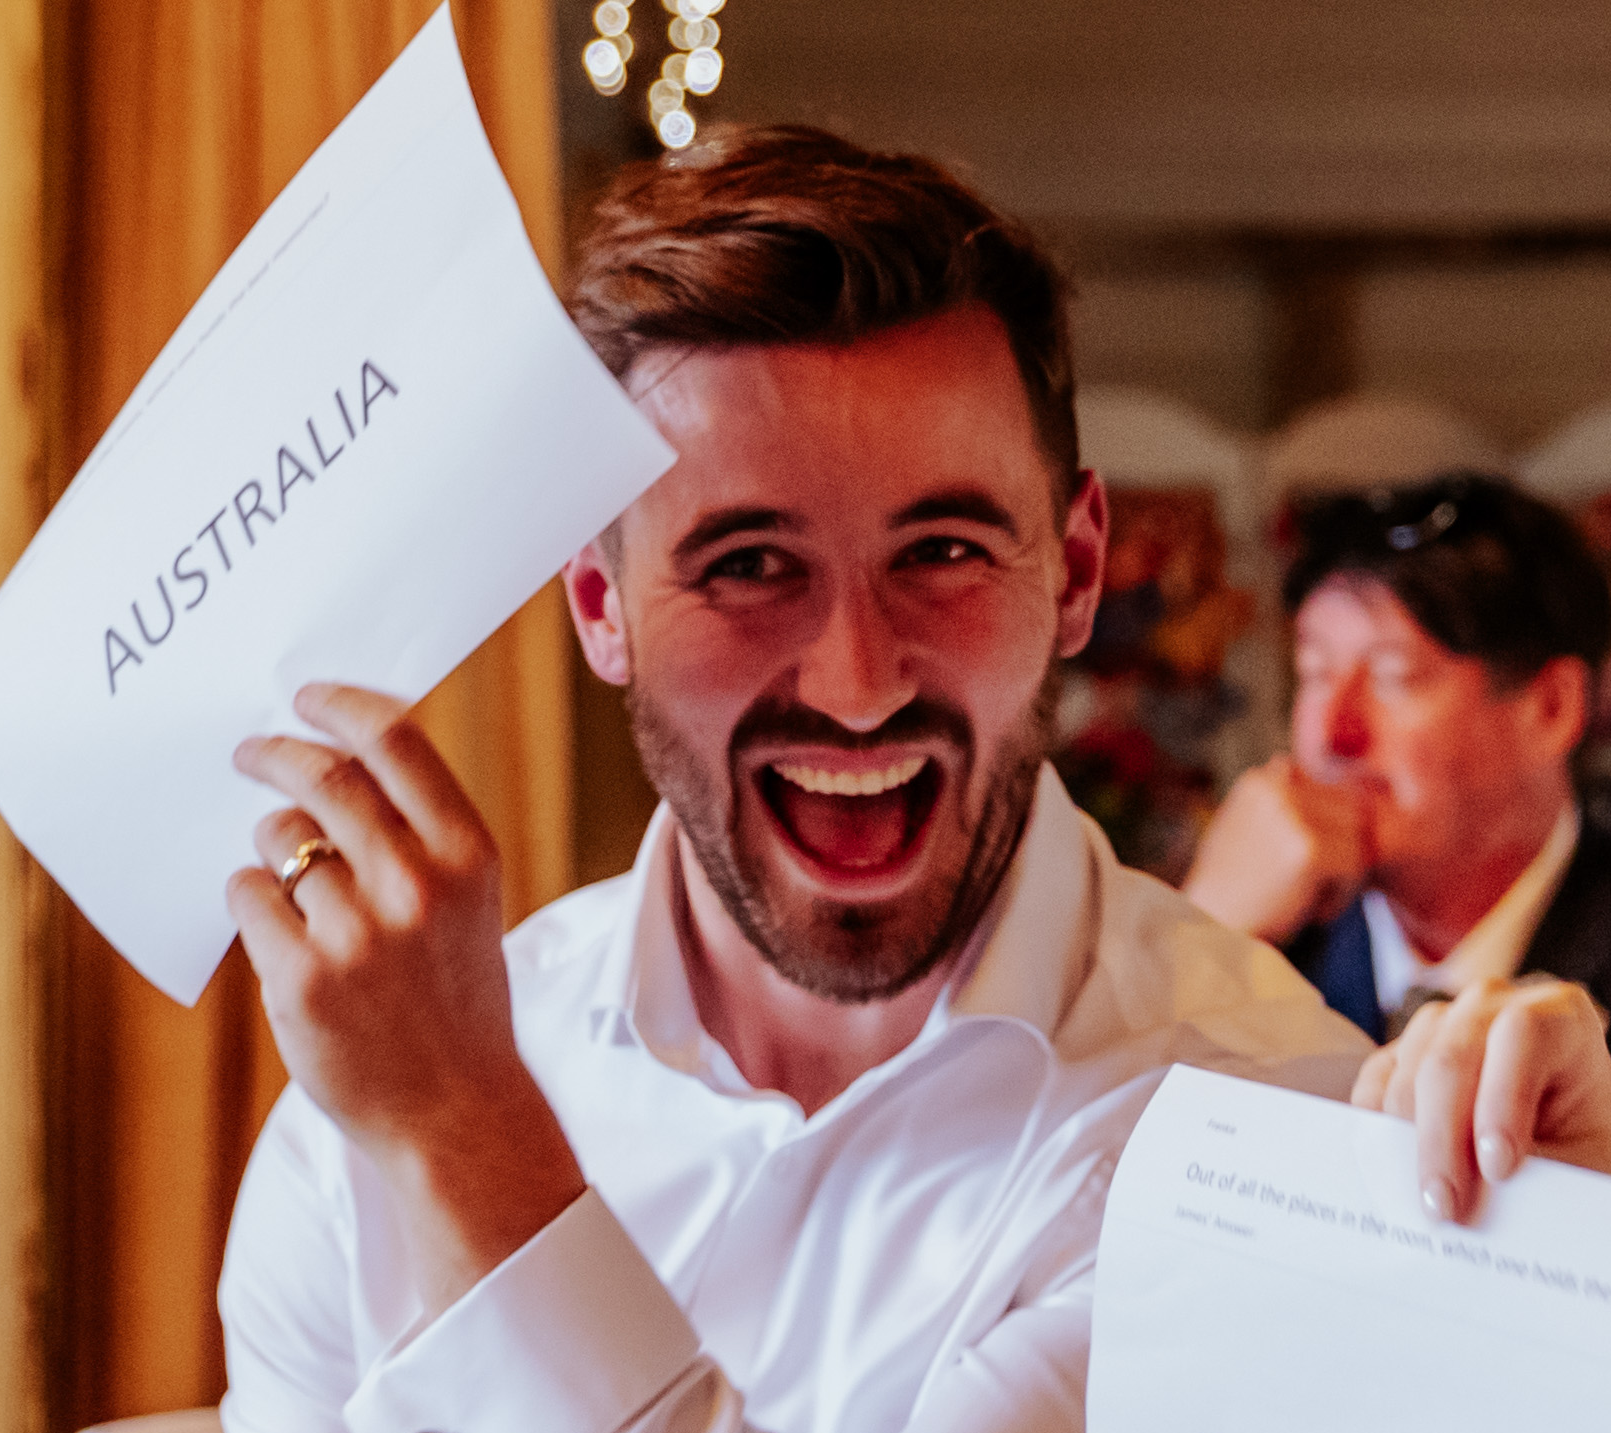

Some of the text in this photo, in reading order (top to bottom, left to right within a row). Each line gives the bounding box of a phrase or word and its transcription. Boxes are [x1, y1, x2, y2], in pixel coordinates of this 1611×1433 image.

[100, 357, 400, 695] AUSTRALIA
[1186, 1162, 1215, 1187] Out
[1218, 1172, 1237, 1192] of
[1237, 1178, 1257, 1198] all
[1260, 1182, 1286, 1208] the
[1288, 1192, 1339, 1223] places
[1341, 1205, 1356, 1227] in
[1359, 1213, 1387, 1238] the
